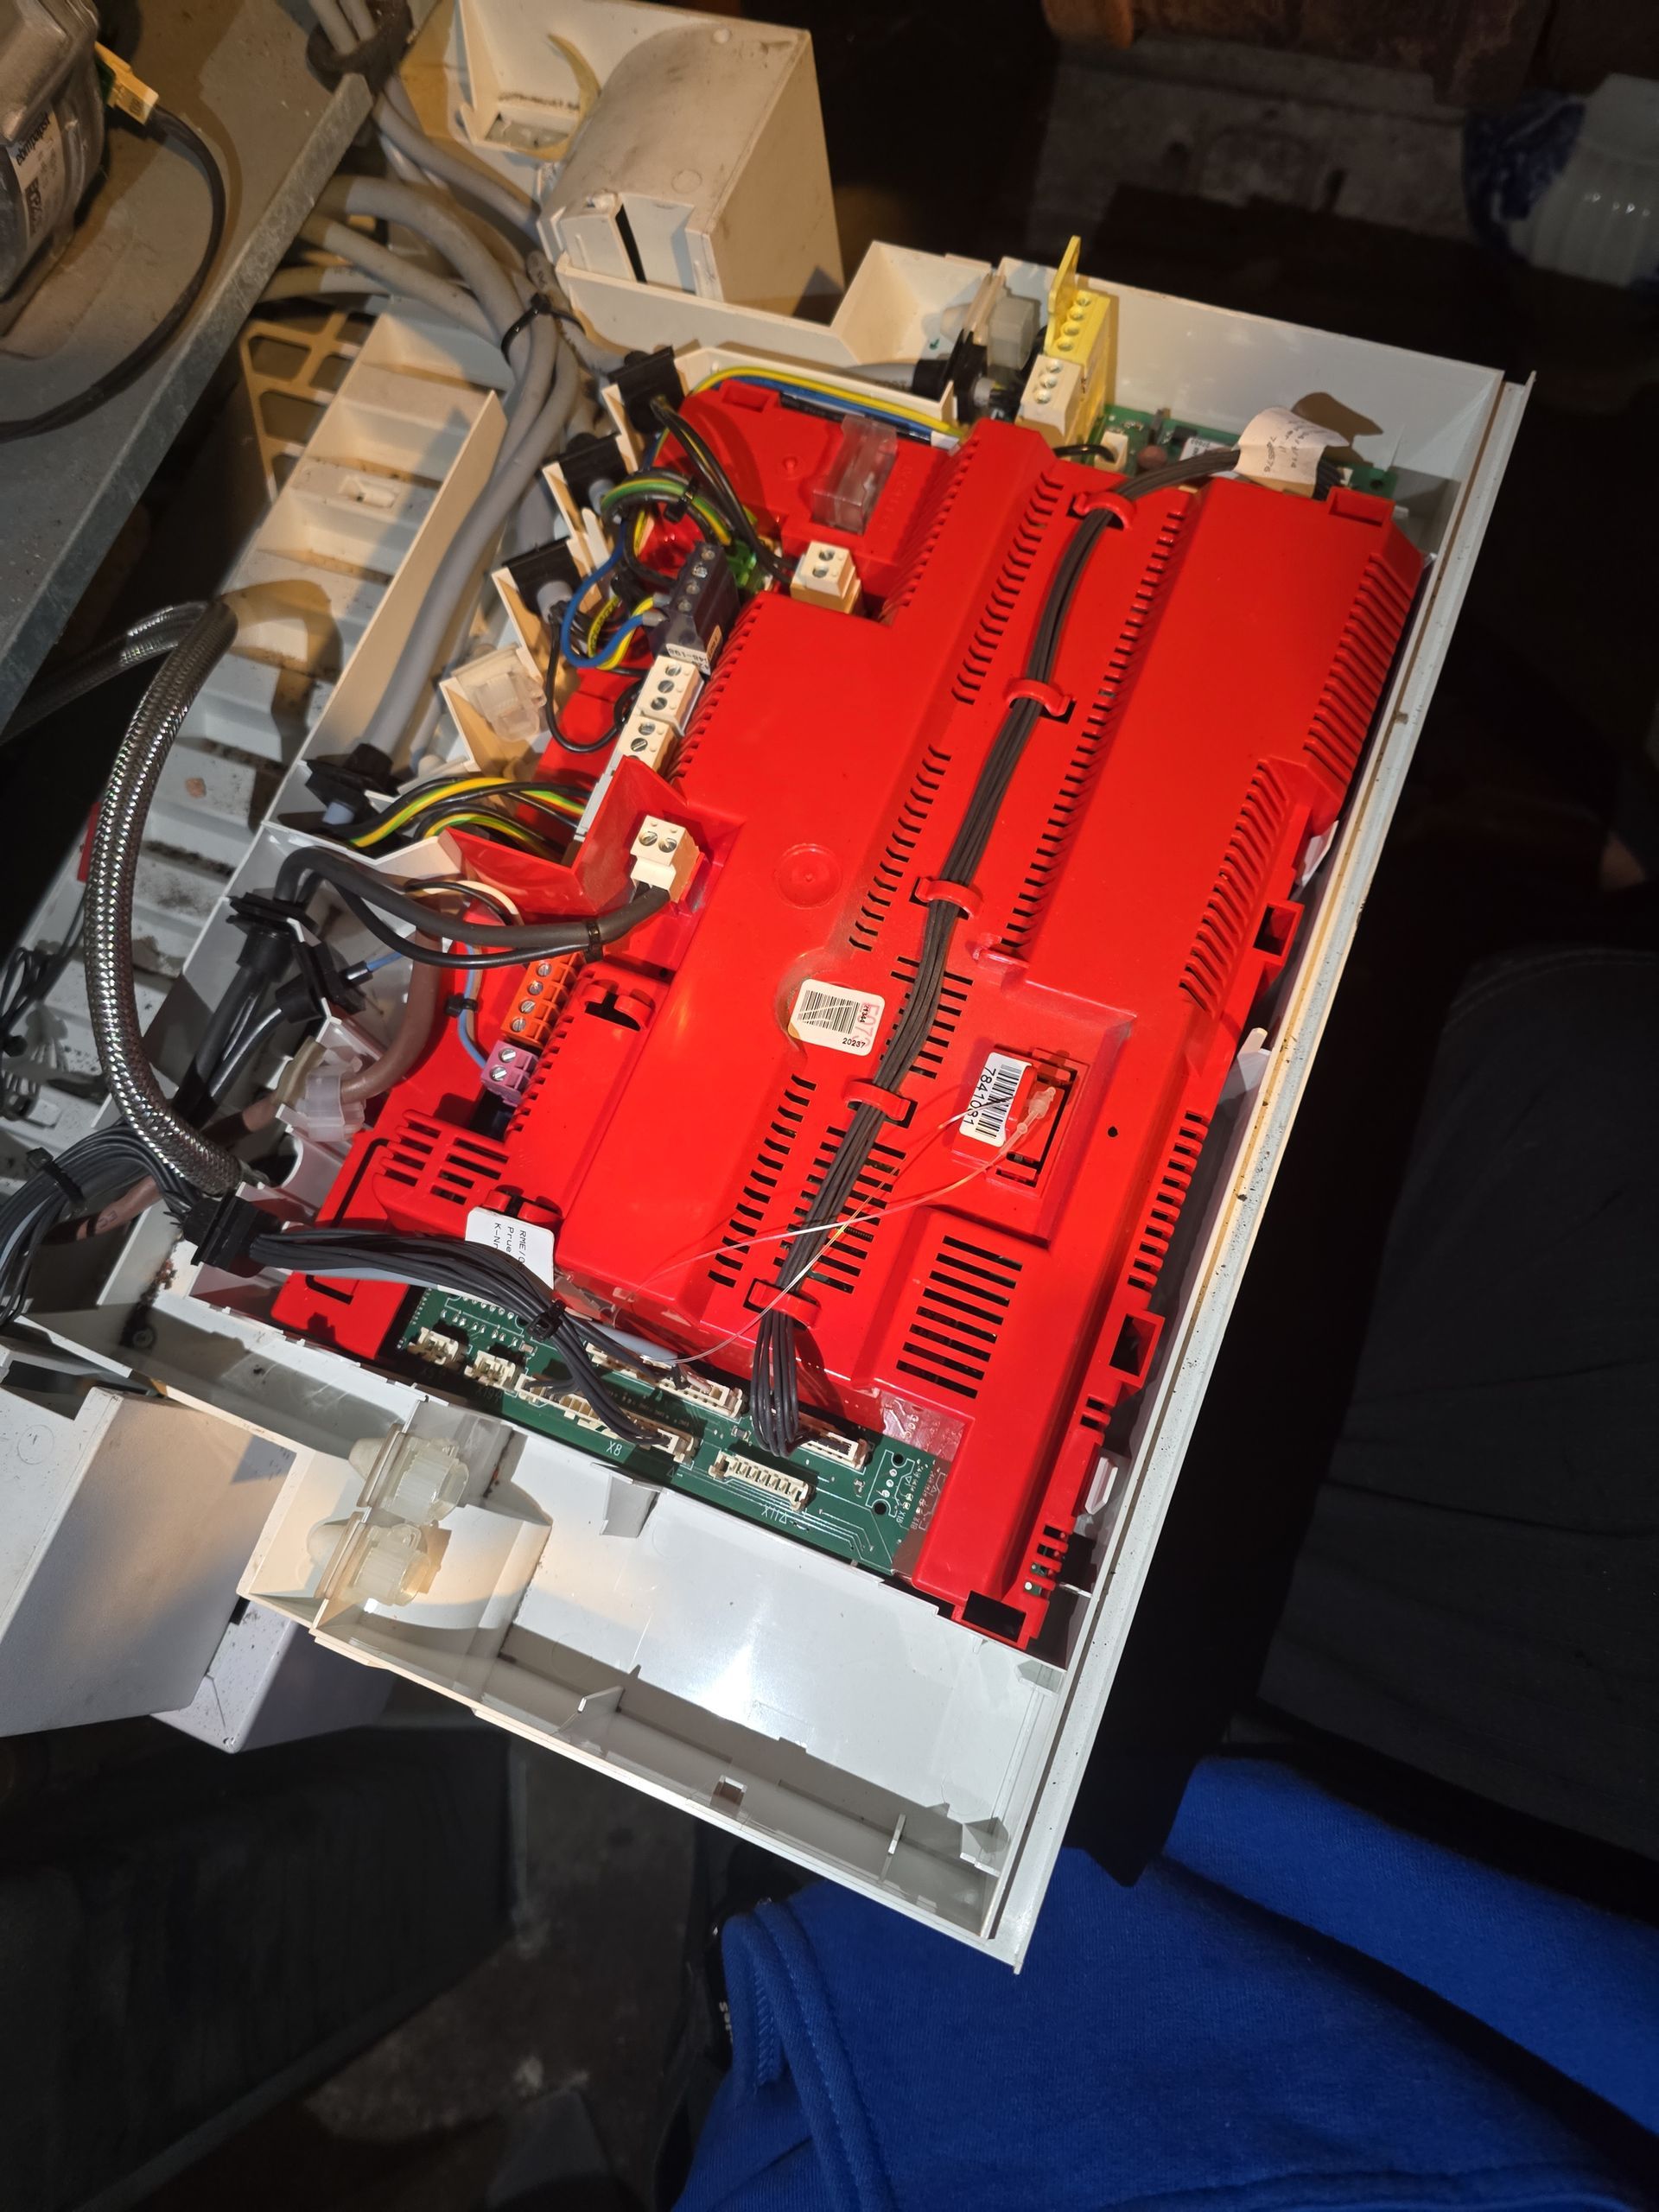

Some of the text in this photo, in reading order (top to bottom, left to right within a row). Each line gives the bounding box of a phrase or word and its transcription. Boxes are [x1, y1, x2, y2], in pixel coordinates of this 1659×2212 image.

[16, 111, 51, 166] ebmpapst
[842, 1038, 866, 1048] 20237
[963, 1067, 996, 1125] 7841081
[606, 1440, 623, 1456] X8
